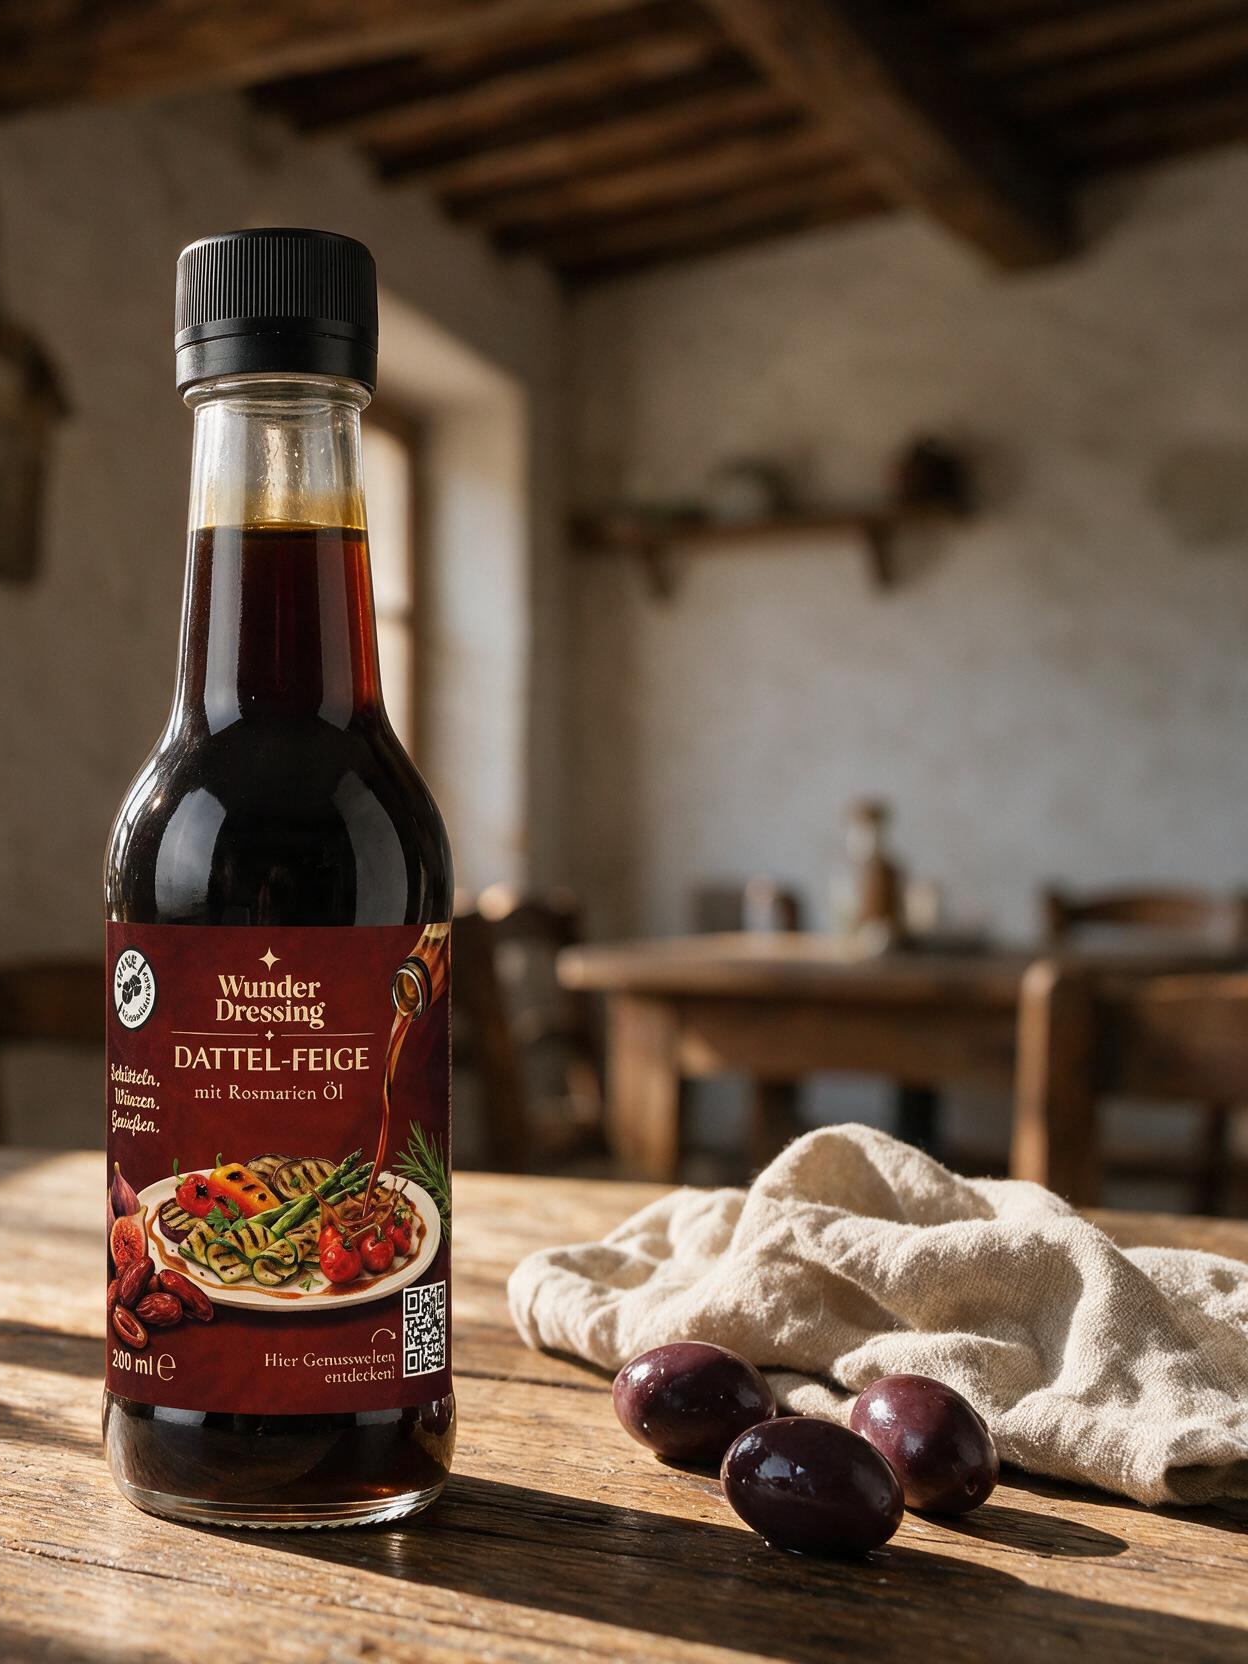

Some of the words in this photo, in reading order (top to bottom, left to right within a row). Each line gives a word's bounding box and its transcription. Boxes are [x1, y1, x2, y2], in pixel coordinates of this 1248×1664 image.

[217, 974, 321, 998] Wunder
[215, 998, 326, 1030] Dressing
[174, 1045, 370, 1072] DATTEL-FEIGE
[194, 1084, 222, 1099] mit
[228, 1084, 317, 1100] Rosmarien
[323, 1081, 343, 1100] Öl
[112, 1348, 132, 1371] 200
[135, 1354, 153, 1376] ml
[264, 1352, 299, 1367] Hier
[303, 1349, 396, 1367] Genusswelten
[324, 1365, 395, 1384] entdecken!
